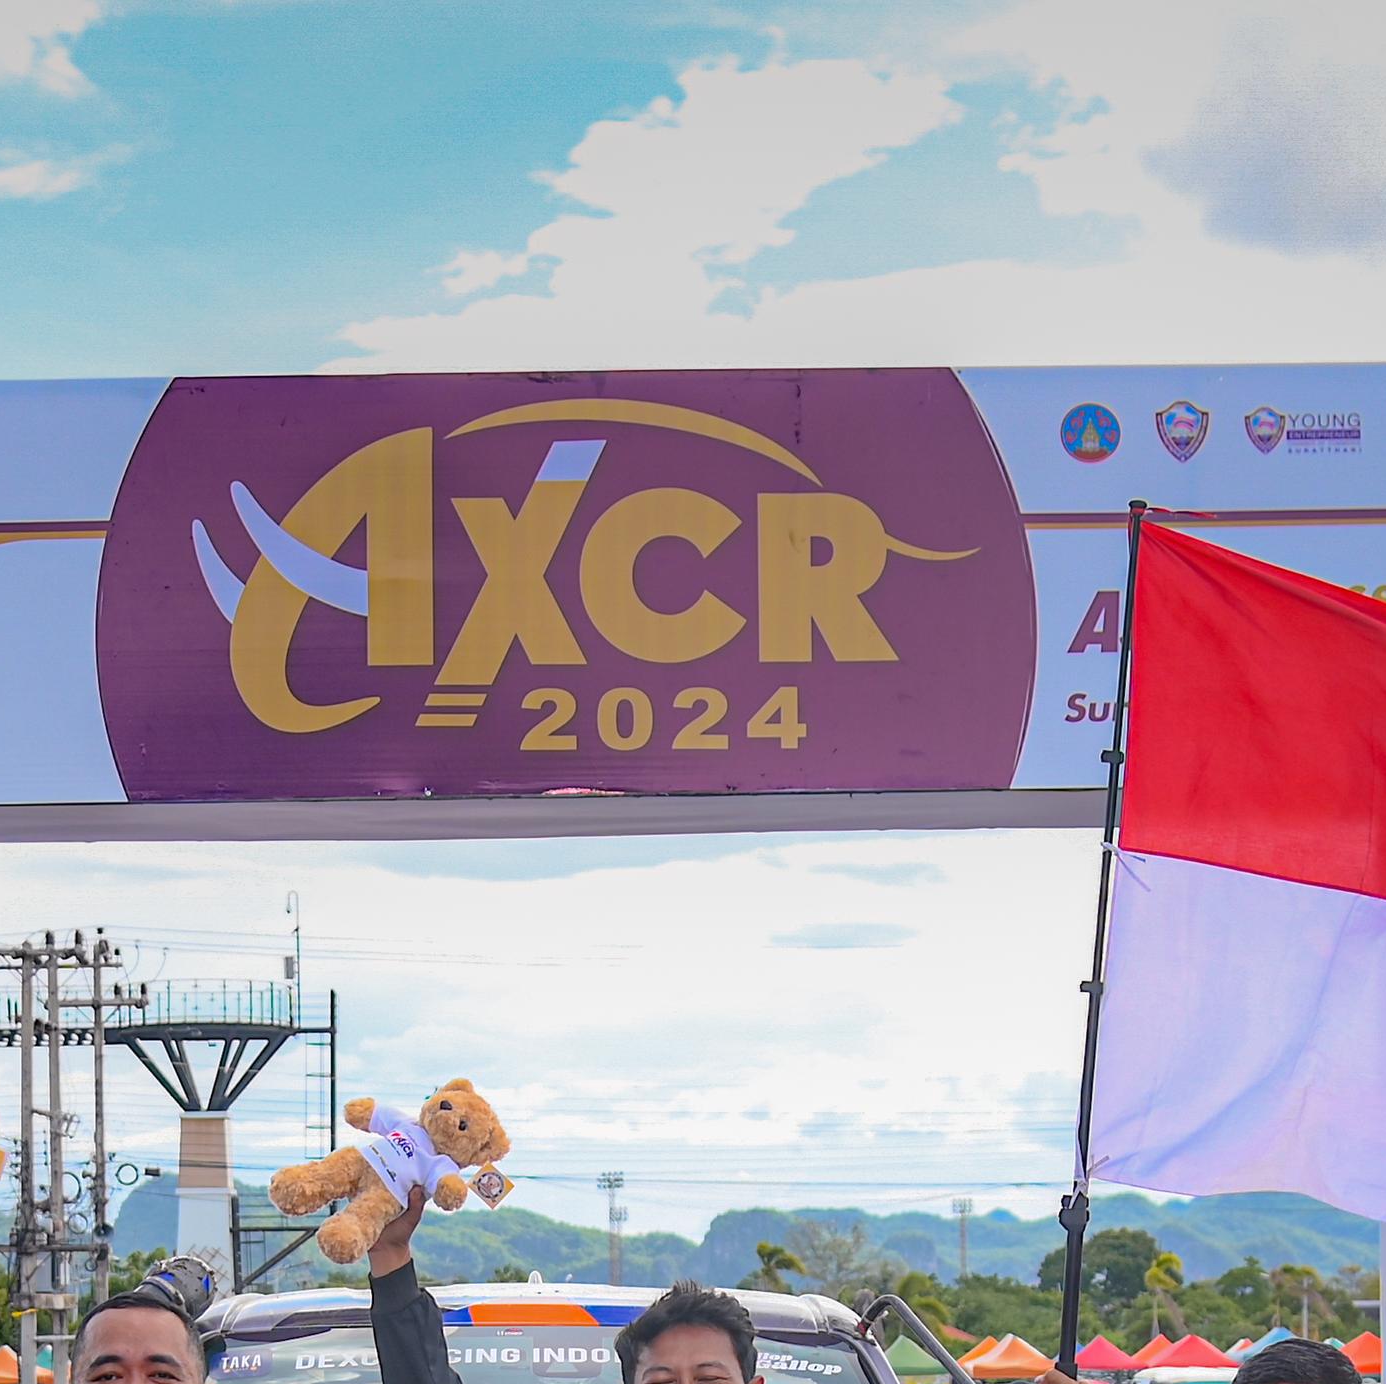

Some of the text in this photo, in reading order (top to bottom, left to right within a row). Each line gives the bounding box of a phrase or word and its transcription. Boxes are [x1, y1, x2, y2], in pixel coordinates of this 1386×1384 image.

[1288, 413, 1361, 428] YOUNG
[213, 420, 923, 733] AXCR
[519, 687, 810, 750] 2024
[220, 1353, 262, 1371] TAKA
[446, 1347, 522, 1364] CING
